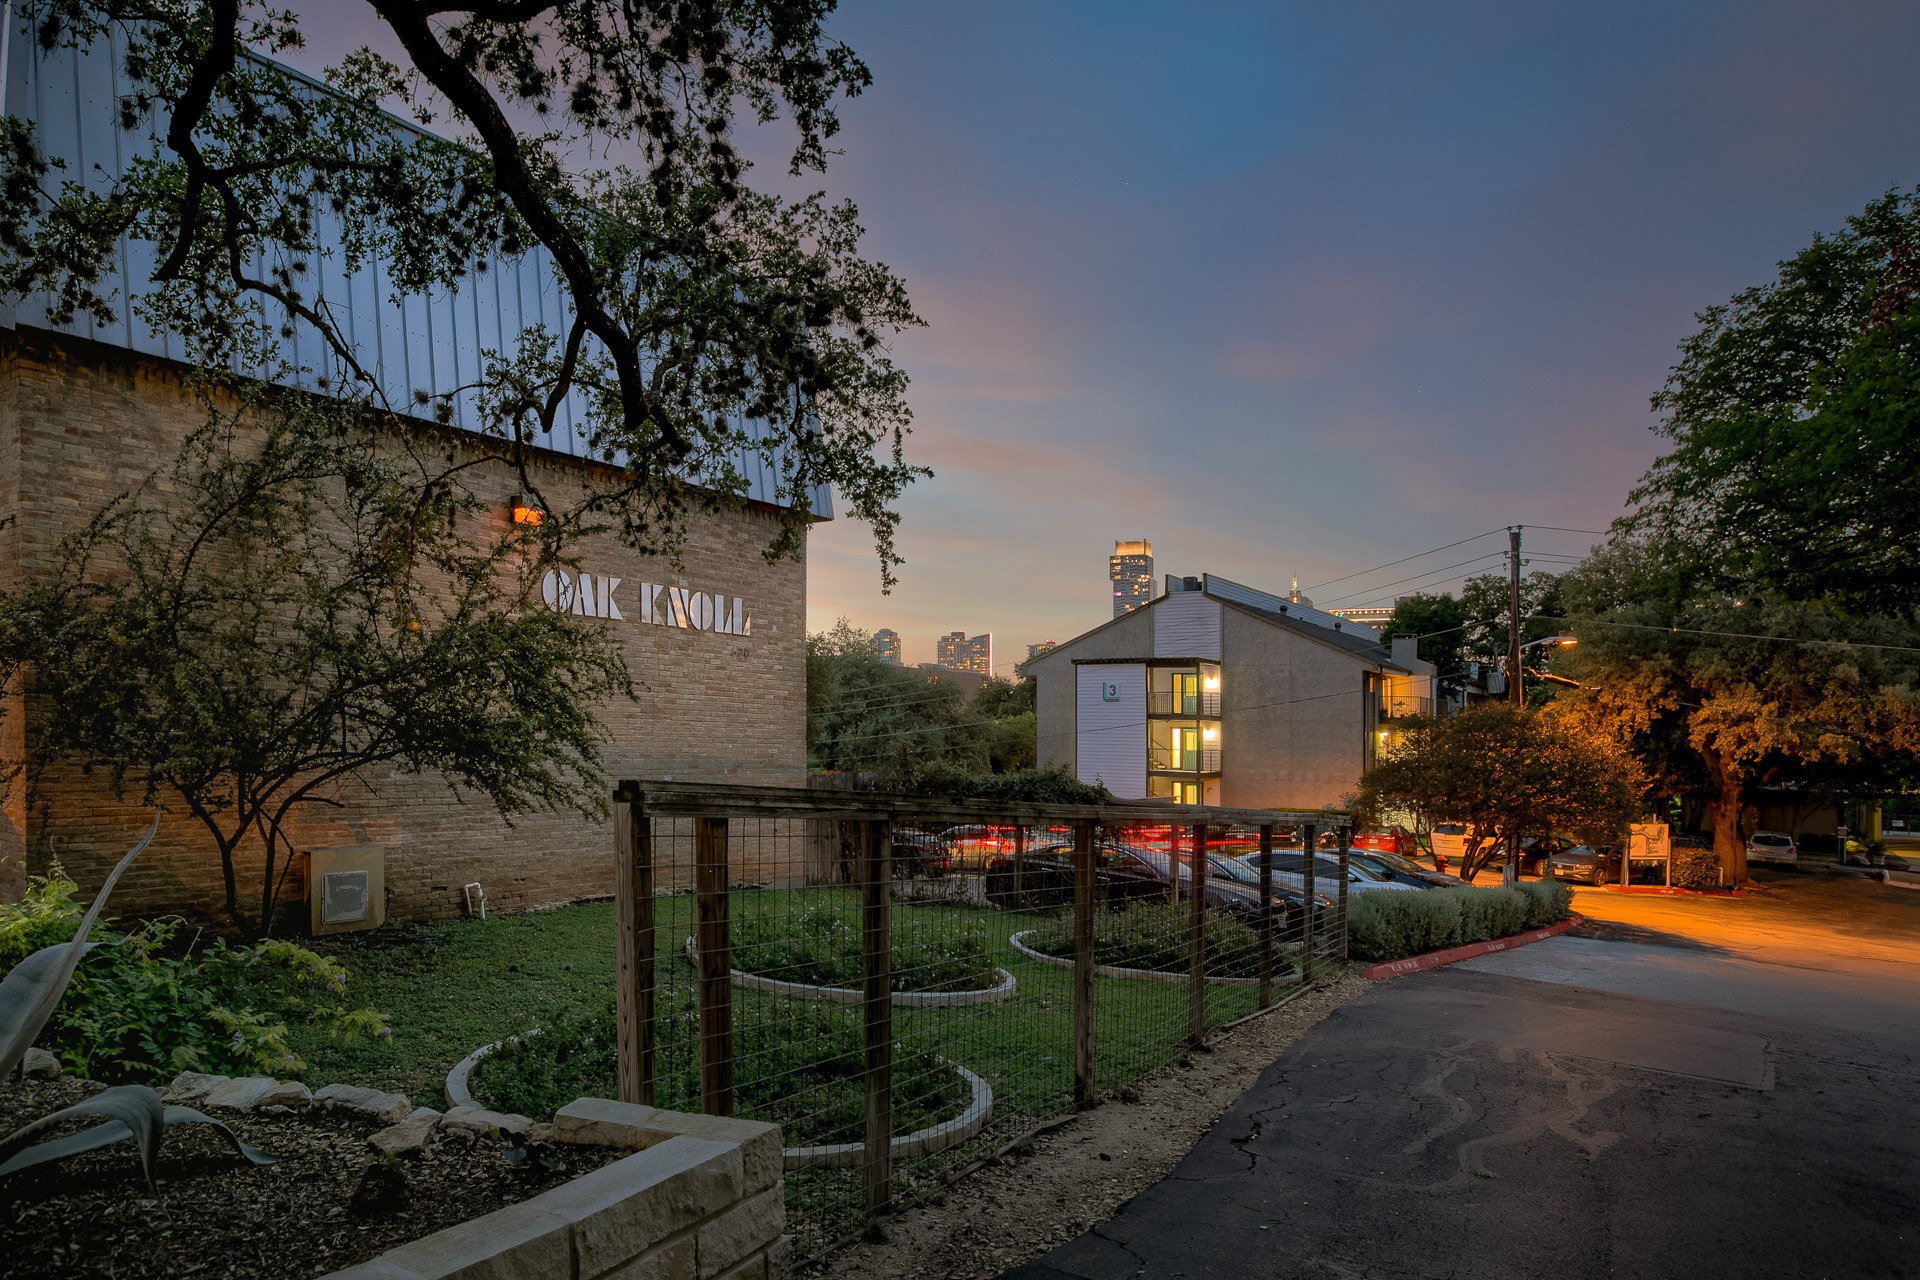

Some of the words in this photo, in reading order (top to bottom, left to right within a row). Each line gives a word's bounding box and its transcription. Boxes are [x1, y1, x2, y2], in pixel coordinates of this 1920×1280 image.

[541, 568, 623, 621] OAK
[640, 582, 750, 636] KNOLL
[1108, 684, 1117, 697] 3
